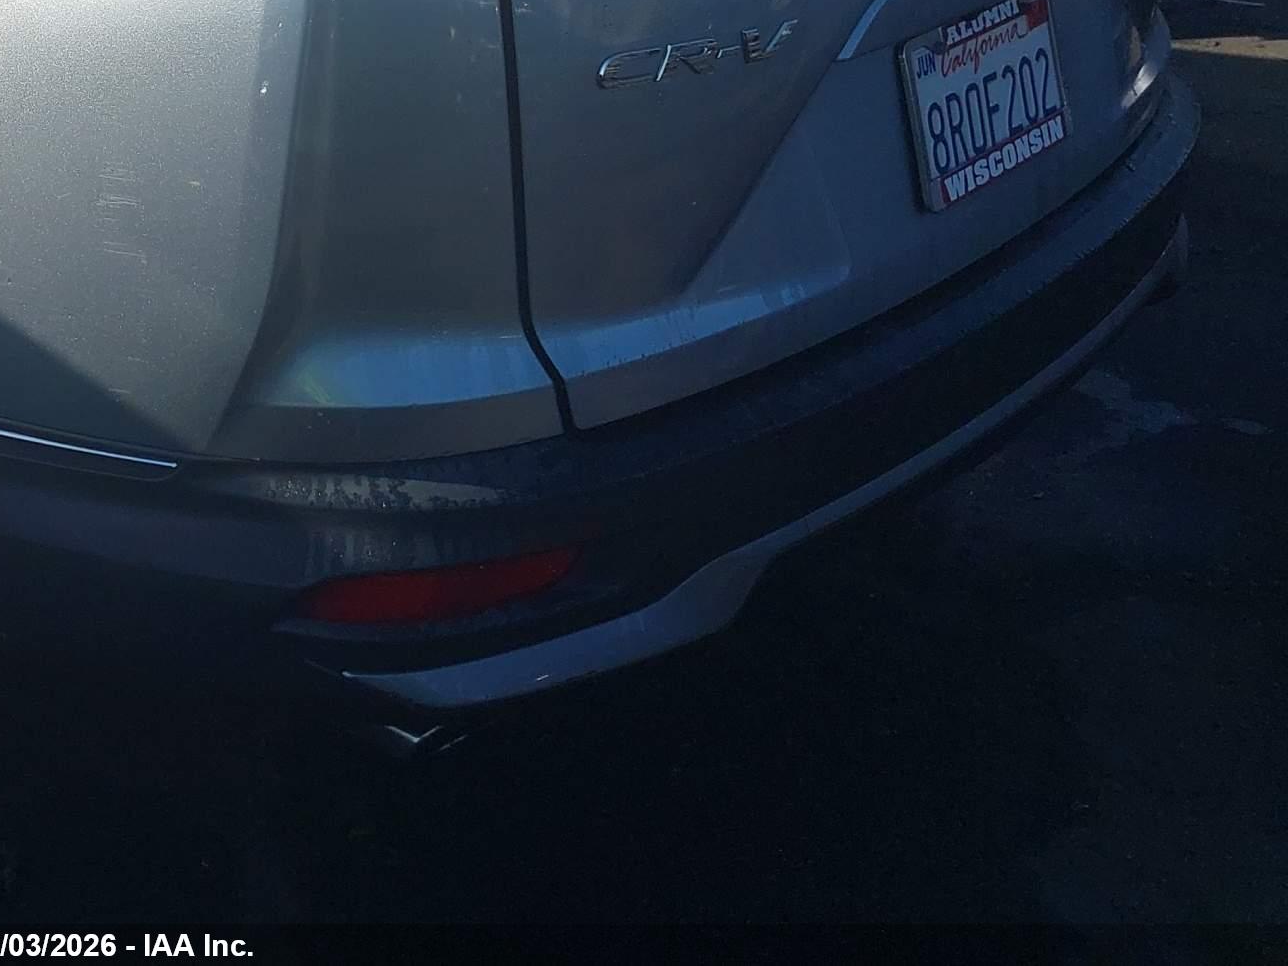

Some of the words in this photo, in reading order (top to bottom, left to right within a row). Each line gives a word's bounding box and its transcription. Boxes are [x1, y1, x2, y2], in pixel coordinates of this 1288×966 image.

[596, 18, 799, 90] CR-V
[916, 51, 937, 79] JUN
[941, 22, 1028, 78] California
[943, 115, 1064, 202] WISCONSIN
